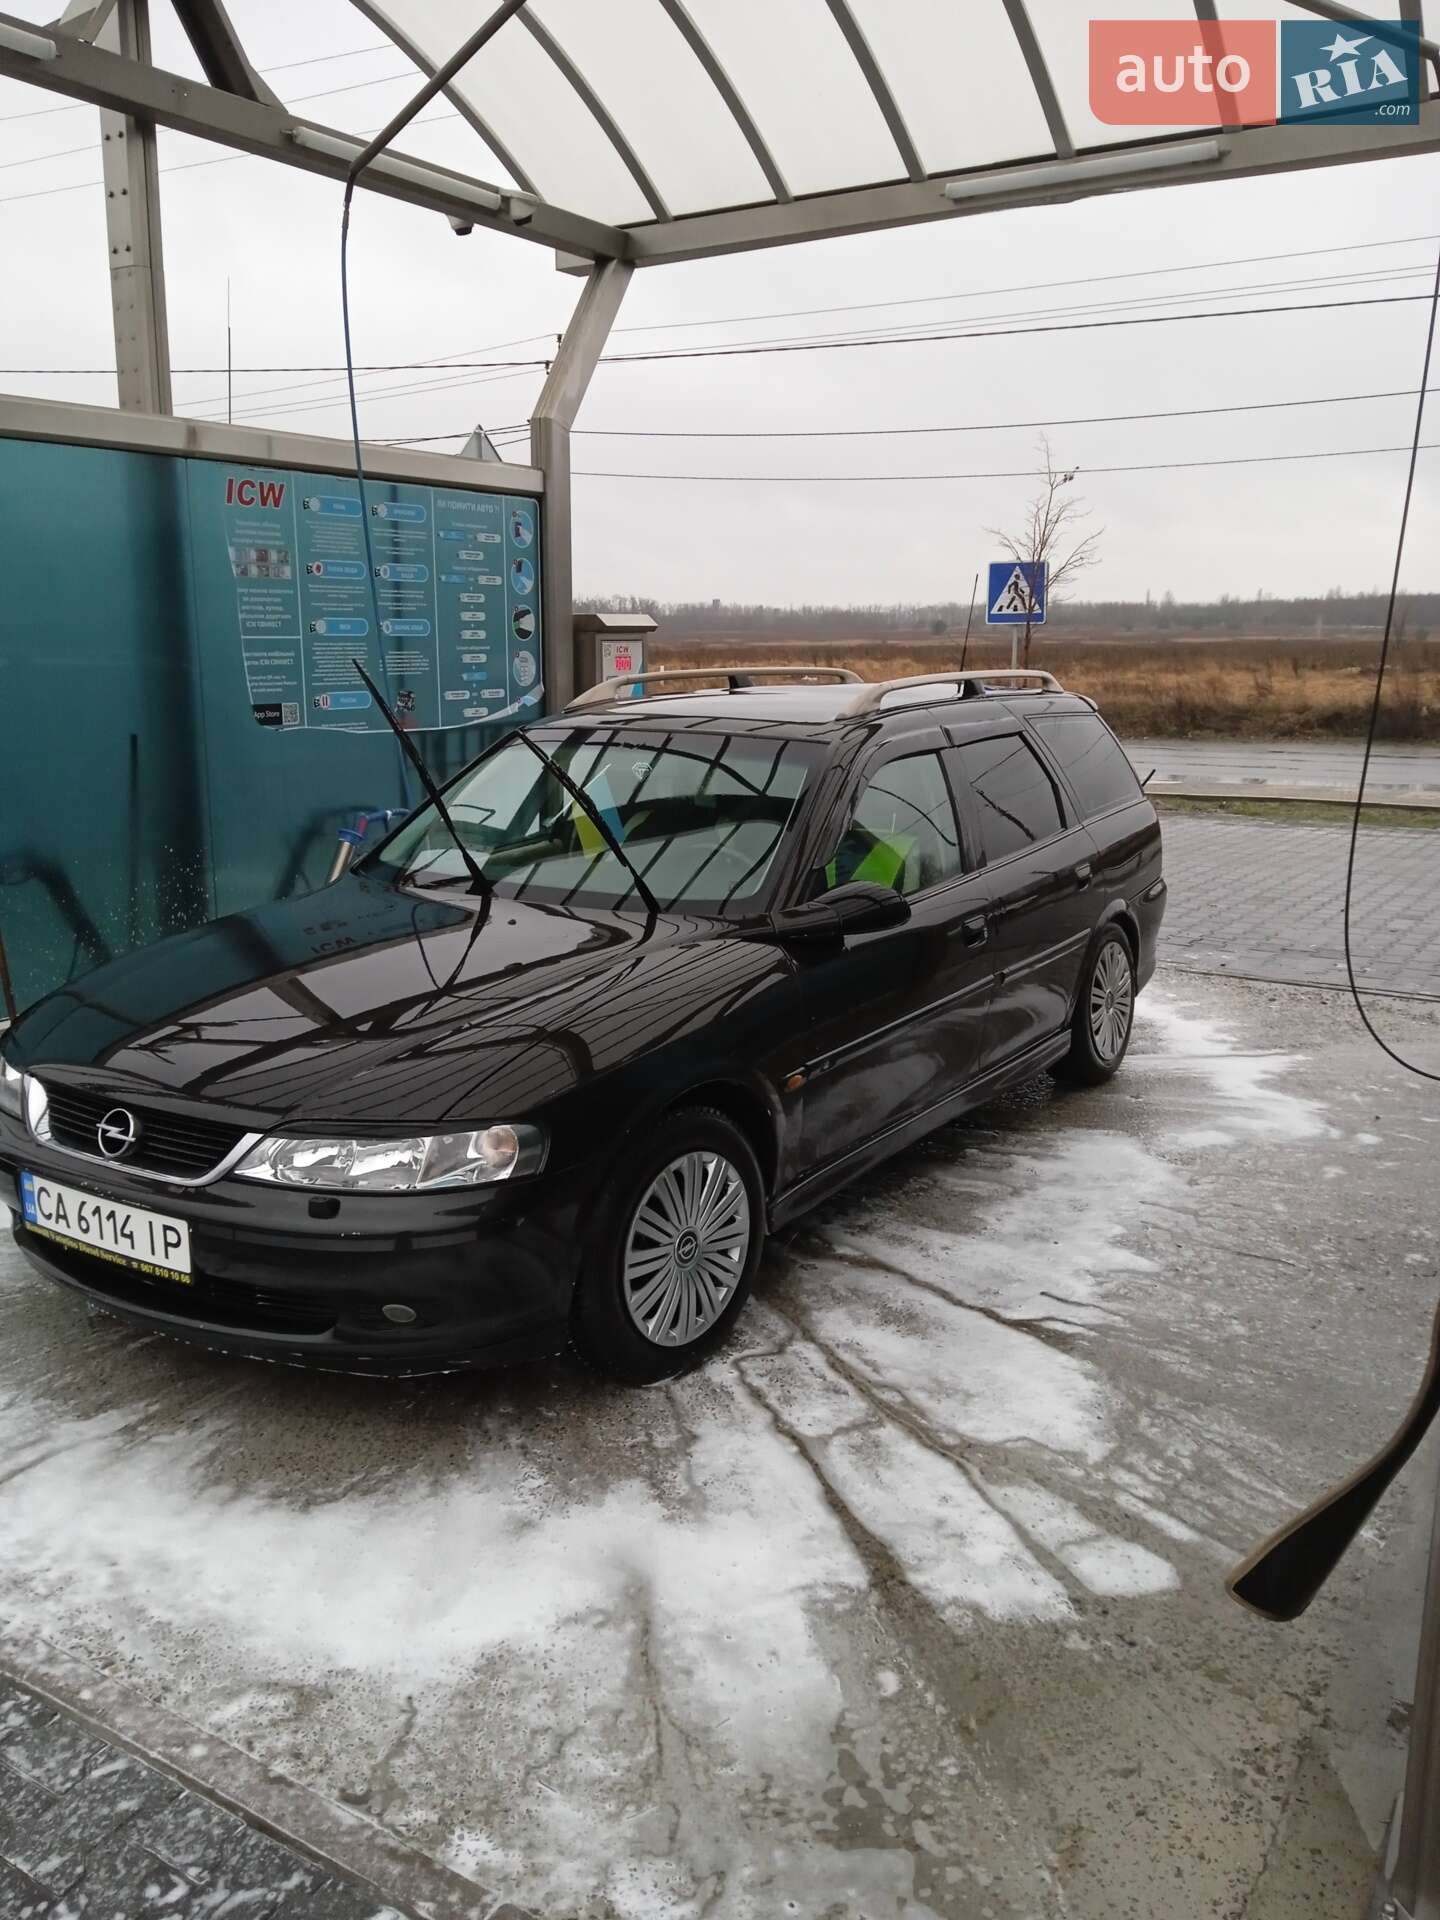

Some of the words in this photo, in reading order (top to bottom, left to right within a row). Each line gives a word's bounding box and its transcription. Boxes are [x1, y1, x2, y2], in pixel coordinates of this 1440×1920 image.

[225, 477, 285, 510] ICW
[37, 1186, 71, 1229] CA
[77, 1201, 135, 1250] 6114
[148, 1220, 182, 1260] IP
